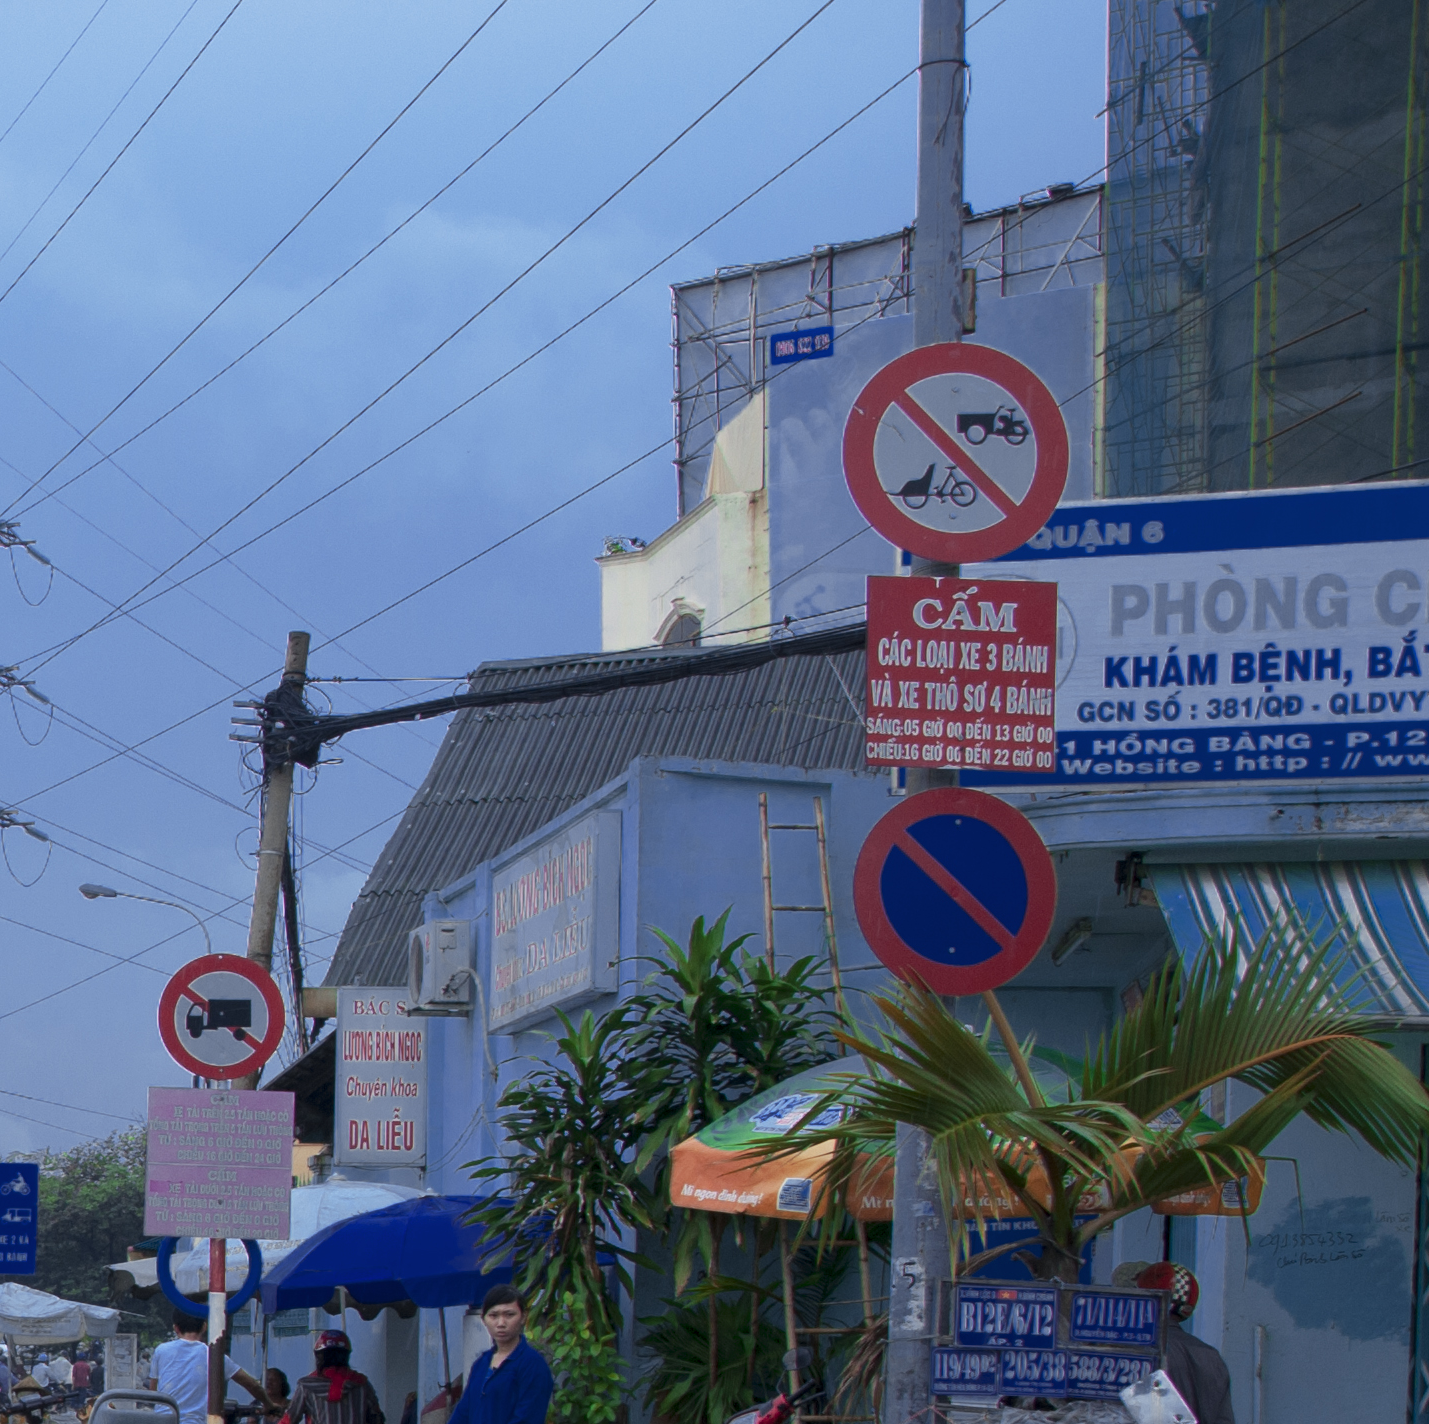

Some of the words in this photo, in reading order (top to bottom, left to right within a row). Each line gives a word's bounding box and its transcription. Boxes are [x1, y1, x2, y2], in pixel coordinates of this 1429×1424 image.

[1027, 519, 1132, 554] QUẬN
[1141, 521, 1165, 544] 6
[913, 586, 1018, 632] CẤM
[1108, 563, 1349, 637] PHÒNG
[878, 631, 912, 667] CÁC
[916, 640, 954, 674] LOẠI
[959, 642, 981, 670] XE
[986, 643, 997, 671] 3
[1002, 637, 1048, 674] BÁNH
[1103, 646, 1218, 689] KHÁM
[1231, 642, 1353, 693] BỆNH,
[1366, 630, 1429, 680] BẮ
[871, 672, 892, 708] VÀ
[898, 681, 919, 709] XE
[925, 676, 958, 711] THÔ
[963, 681, 988, 713] SƠ
[990, 686, 1001, 713] 4
[1006, 679, 1052, 716] BÁNH
[1076, 700, 1135, 724] GCN
[1144, 690, 1181, 723] SỐ
[1206, 695, 1303, 722] 381/QĐ
[923, 717, 944, 737] GIỜ
[965, 717, 991, 740] ĐẾN
[995, 724, 1010, 741] 13
[1013, 721, 1034, 742] GIỜ
[1037, 727, 1053, 743] 00
[1092, 731, 1195, 757] HỒNG
[1208, 728, 1311, 754] BÀNG
[1346, 730, 1427, 749] P.12
[922, 741, 944, 762] GIỜ
[965, 742, 990, 764] ĐẾN
[993, 749, 1009, 766] 22
[1012, 746, 1034, 767] GIỜ
[1036, 751, 1052, 768] 00
[1061, 757, 1202, 776] Website
[1235, 754, 1308, 773] http
[526, 938, 548, 975] DA
[353, 996, 391, 1016] BÁC
[343, 1030, 373, 1062] LƯƠNG
[375, 1024, 397, 1062] BÍCH
[398, 1031, 422, 1069] NGỌC
[346, 1076, 389, 1101] Chuyên
[390, 1077, 418, 1098] khoa
[349, 1119, 371, 1150] DA
[376, 1108, 415, 1151] LIỄU
[11, 1235, 16, 1244] 2
[959, 1302, 1053, 1336] B12E/6/12
[1005, 1351, 1066, 1382] 205/38
